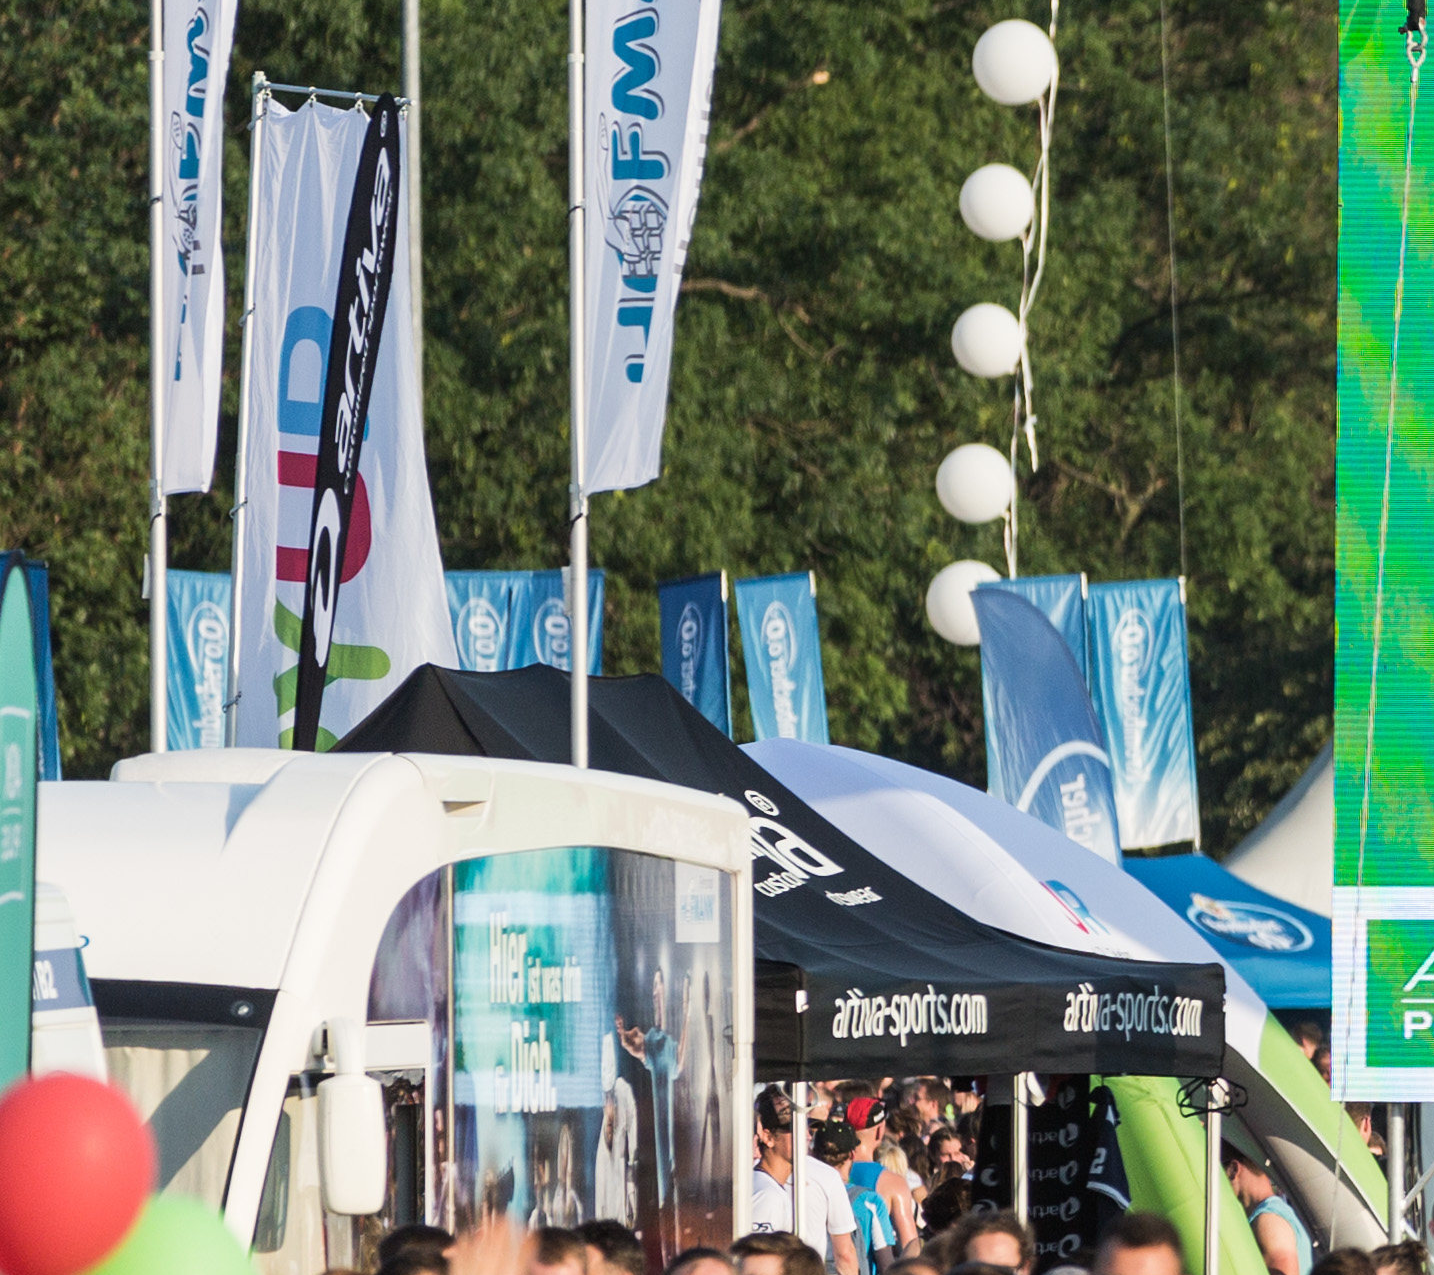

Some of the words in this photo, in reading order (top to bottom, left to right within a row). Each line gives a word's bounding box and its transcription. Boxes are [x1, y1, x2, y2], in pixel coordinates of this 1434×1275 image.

[334, 146, 392, 475] artiva
[489, 911, 526, 1005] Hier
[832, 984, 988, 1047] artiva-sports.com
[1063, 982, 1203, 1042] artiva-sports.com
[511, 1019, 557, 1115] Dich.
